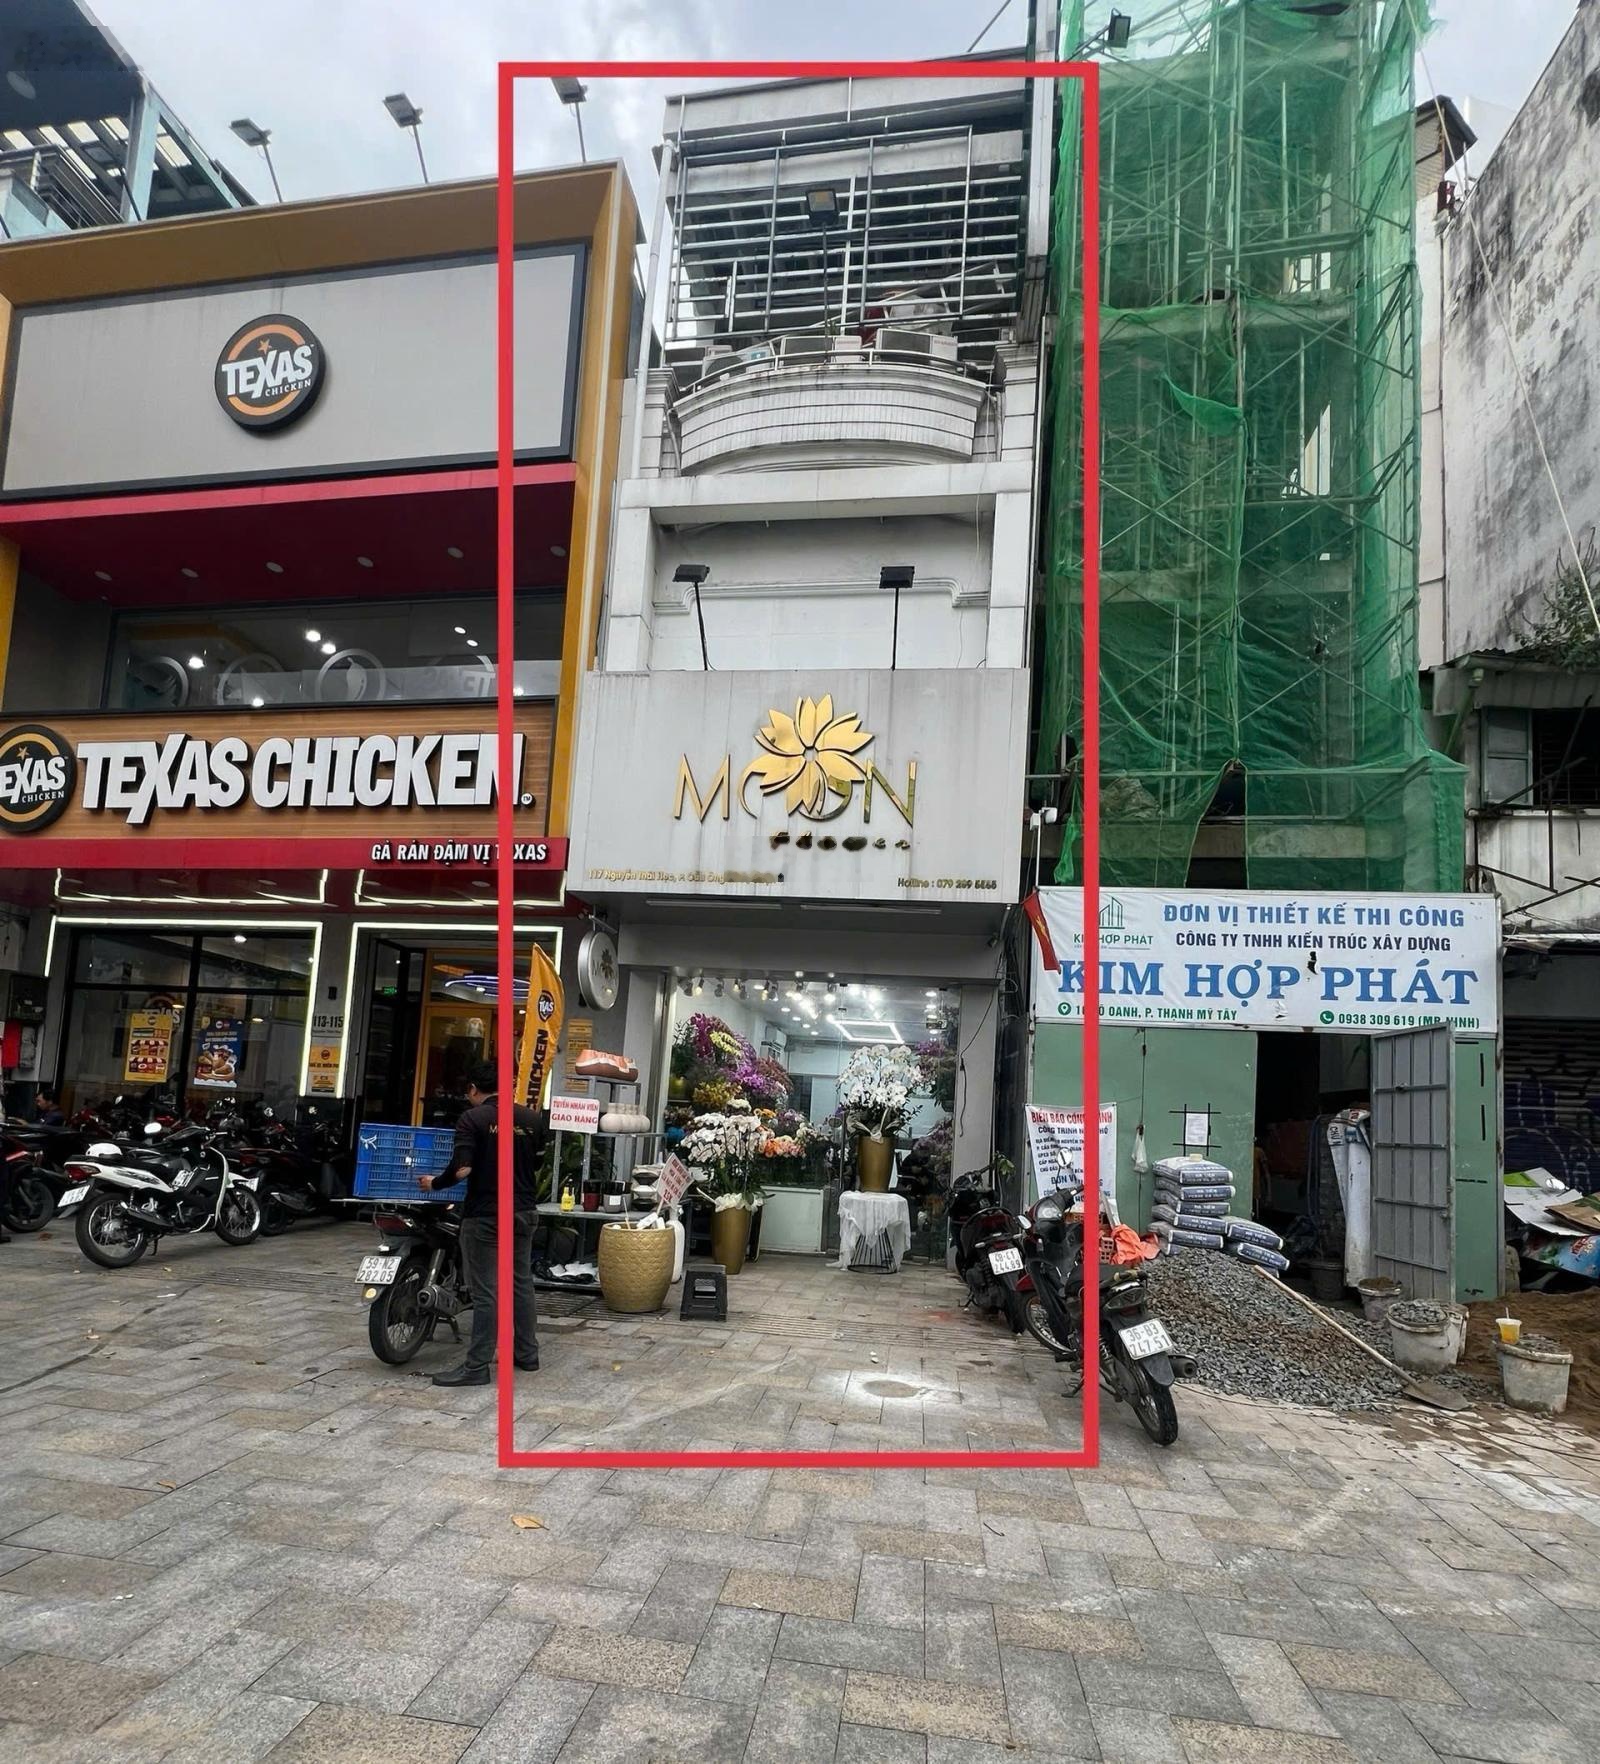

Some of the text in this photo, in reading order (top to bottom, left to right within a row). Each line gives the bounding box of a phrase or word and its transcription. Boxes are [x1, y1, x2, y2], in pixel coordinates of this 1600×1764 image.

[222, 345, 313, 399] TEXAS
[265, 379, 311, 397] CHICKEN
[0, 756, 66, 804] EXAS
[76, 733, 248, 824] TEXAS
[252, 733, 524, 808] CHICKEN
[21, 790, 65, 803] CHICKEN
[371, 839, 391, 860] GÀ
[397, 839, 429, 860] RÁN
[434, 839, 468, 866] ĐẬM
[473, 844, 490, 865] VỊ
[588, 870, 603, 879] 117
[1163, 901, 1465, 927] ĐƠN VỊ THIẾT KẾ THI CÔNG
[1176, 930, 1451, 953] CÔNG TY TNHH KIẾN TRÚC XÂY DỰNG
[1058, 958, 1479, 1008] KIM HỢP PHÁT
[313, 1016, 344, 1028] 113-115
[1108, 1006, 1141, 1019] OANH,
[1145, 1008, 1154, 1018] P.
[1157, 1008, 1193, 1021] THẠNH
[1197, 1008, 1213, 1020] MỸ
[1217, 1008, 1237, 1021] TÂY
[1338, 1013, 1367, 1025] 0938
[1369, 1014, 1391, 1026] 309
[1393, 1014, 1415, 1027] 619
[552, 1113, 572, 1122] GIAO
[1067, 1112, 1084, 1124] CÔN
